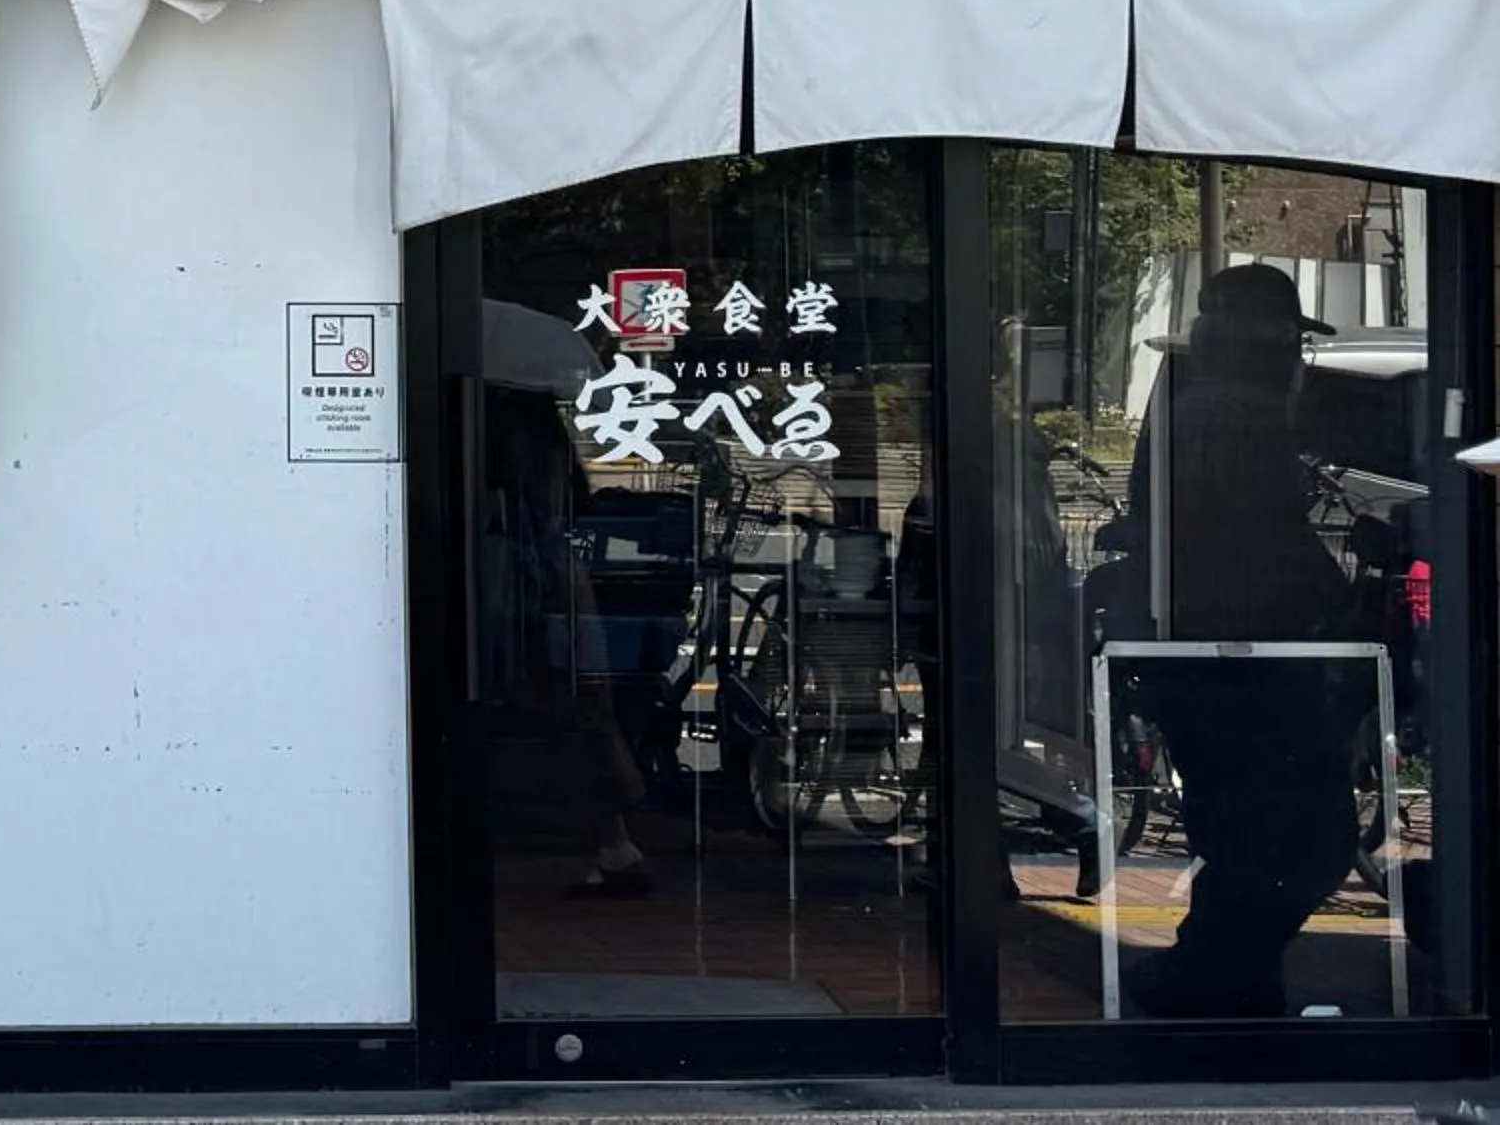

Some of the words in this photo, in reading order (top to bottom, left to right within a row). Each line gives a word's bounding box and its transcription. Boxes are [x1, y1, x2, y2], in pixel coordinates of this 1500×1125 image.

[573, 280, 839, 335] 大衆食堂
[573, 353, 841, 464] 安べゑ
